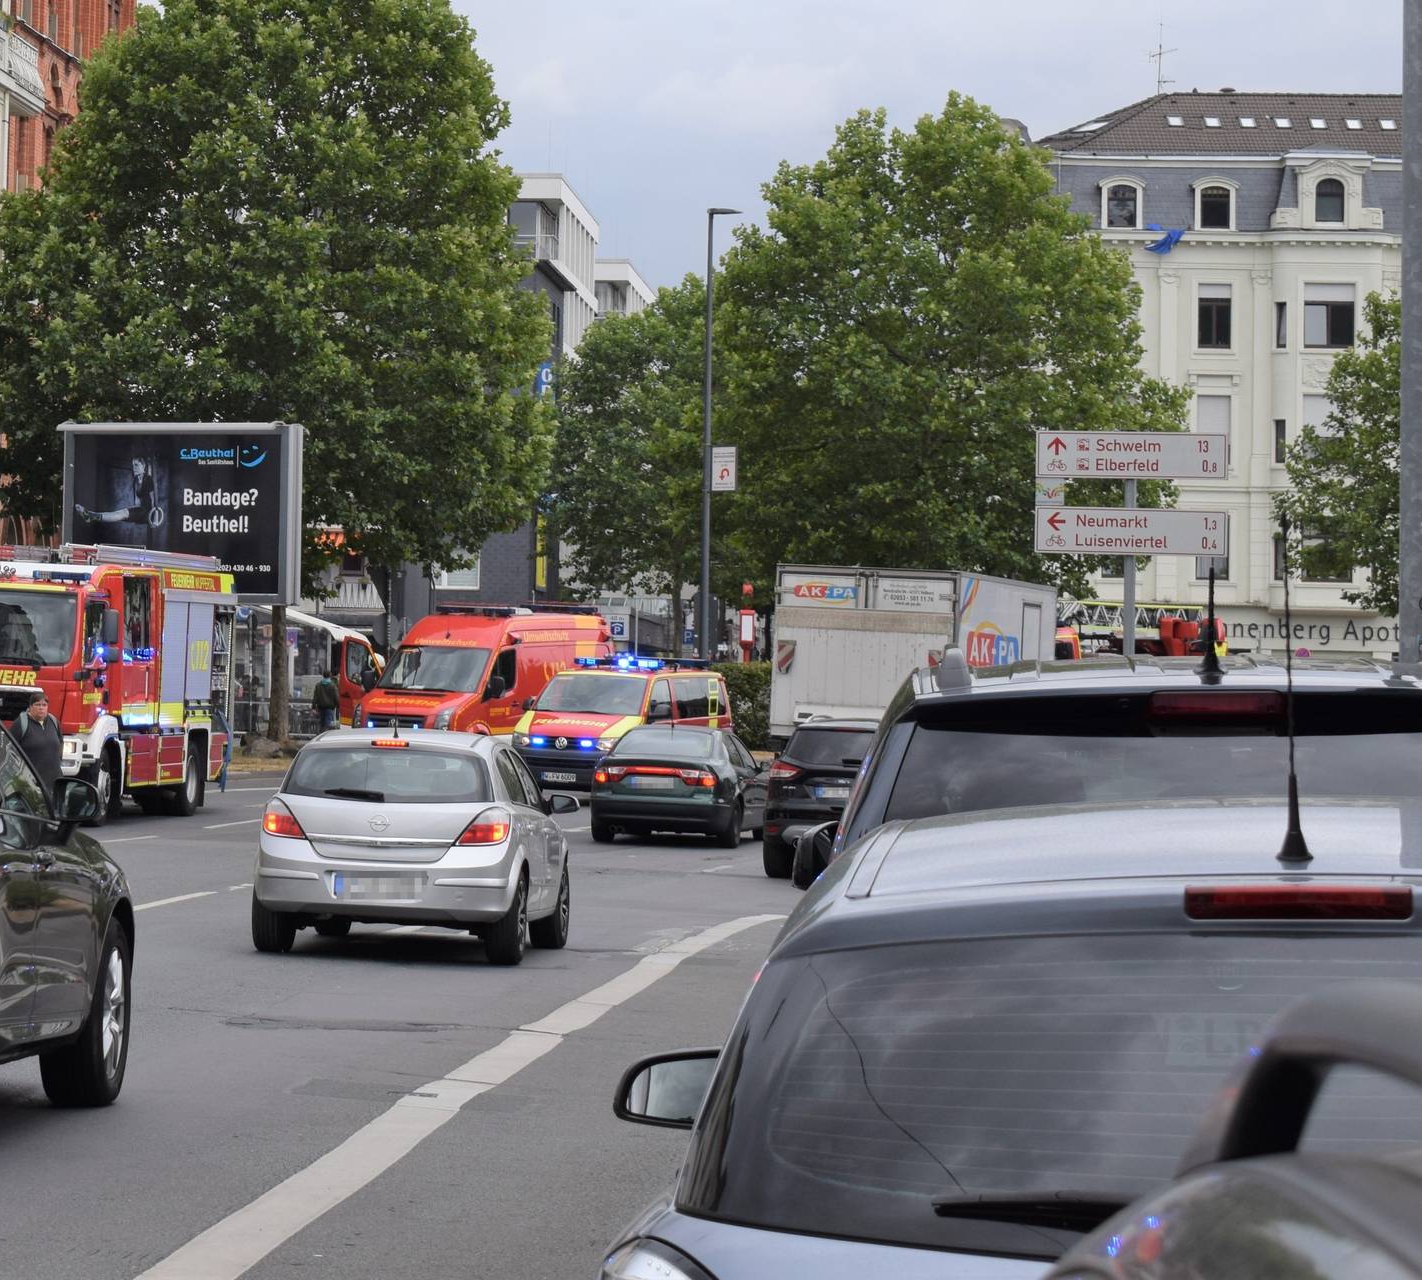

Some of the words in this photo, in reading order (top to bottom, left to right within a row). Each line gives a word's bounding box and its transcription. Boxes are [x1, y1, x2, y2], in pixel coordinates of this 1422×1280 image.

[1096, 439, 1161, 453] Schwelm
[1197, 440, 1209, 453] 13
[1096, 458, 1159, 472] Elberfeld
[183, 488, 259, 510] Bandage?
[182, 515, 249, 533] Beuthel!
[1076, 514, 1148, 529] Neumarkt
[1075, 534, 1167, 549] Luisenviertel
[259, 564, 271, 572] 930
[798, 586, 855, 598] AK-PA
[415, 638, 477, 647] Umweltschutz
[523, 630, 569, 642] Umweltschutz
[970, 636, 1016, 665] AK-PA
[368, 697, 441, 708] FEUERWEHR
[532, 718, 609, 728] FEUERWEHR
